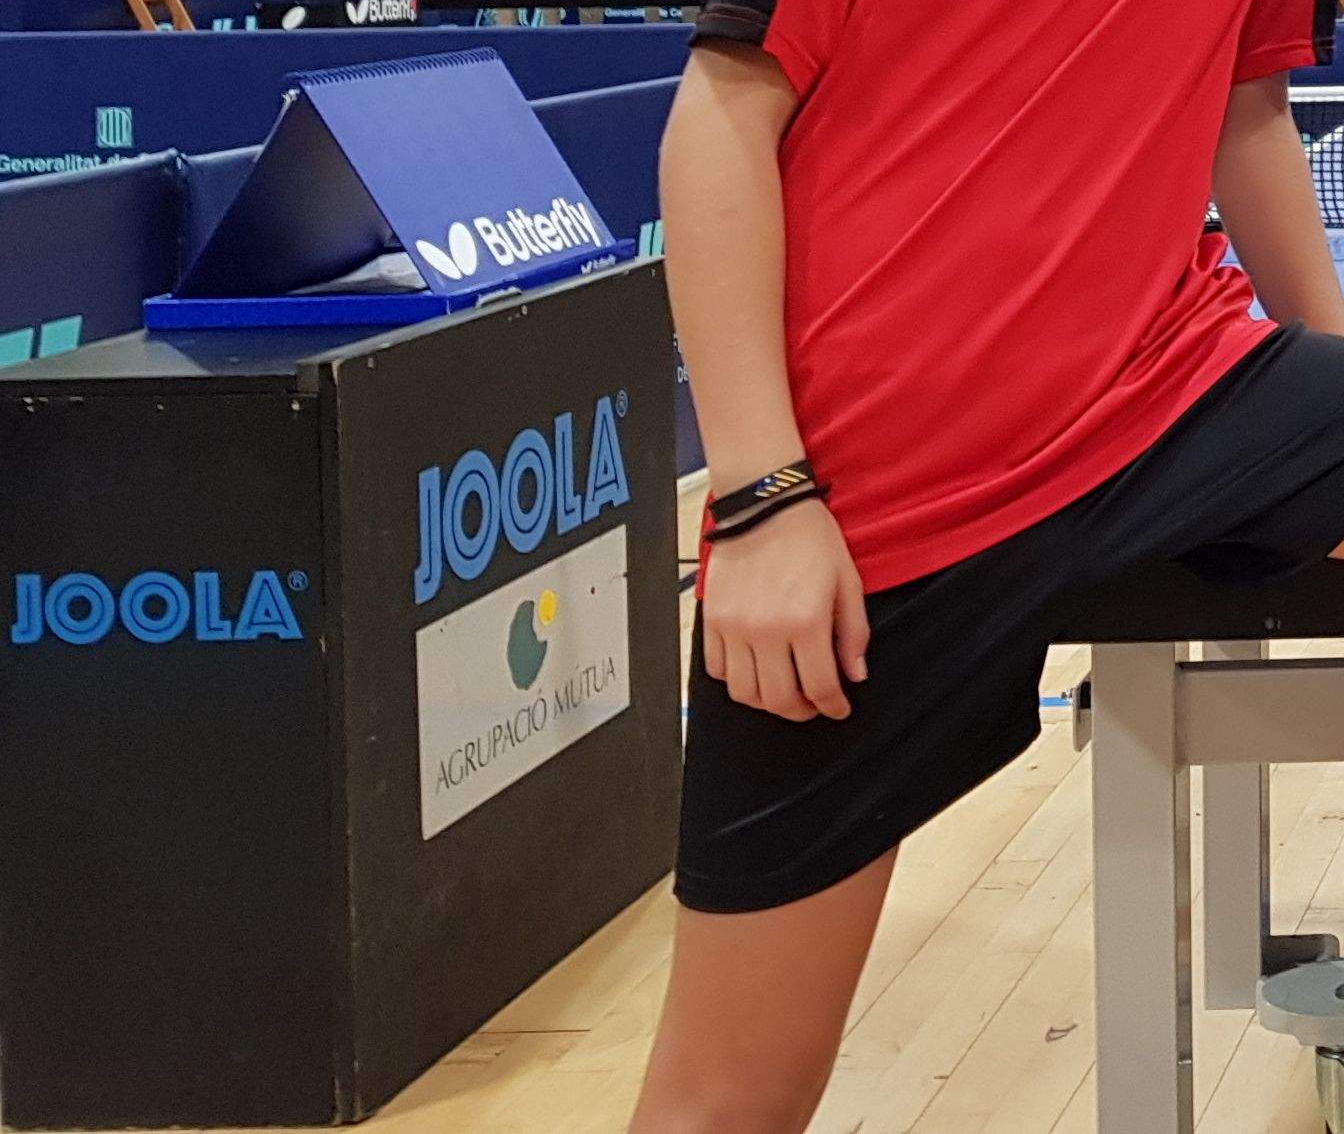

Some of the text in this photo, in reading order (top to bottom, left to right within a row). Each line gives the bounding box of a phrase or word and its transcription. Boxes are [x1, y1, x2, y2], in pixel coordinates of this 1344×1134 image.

[473, 197, 601, 266] Butterfly
[435, 657, 616, 795] AGRUPACIÓ MÚTUA
